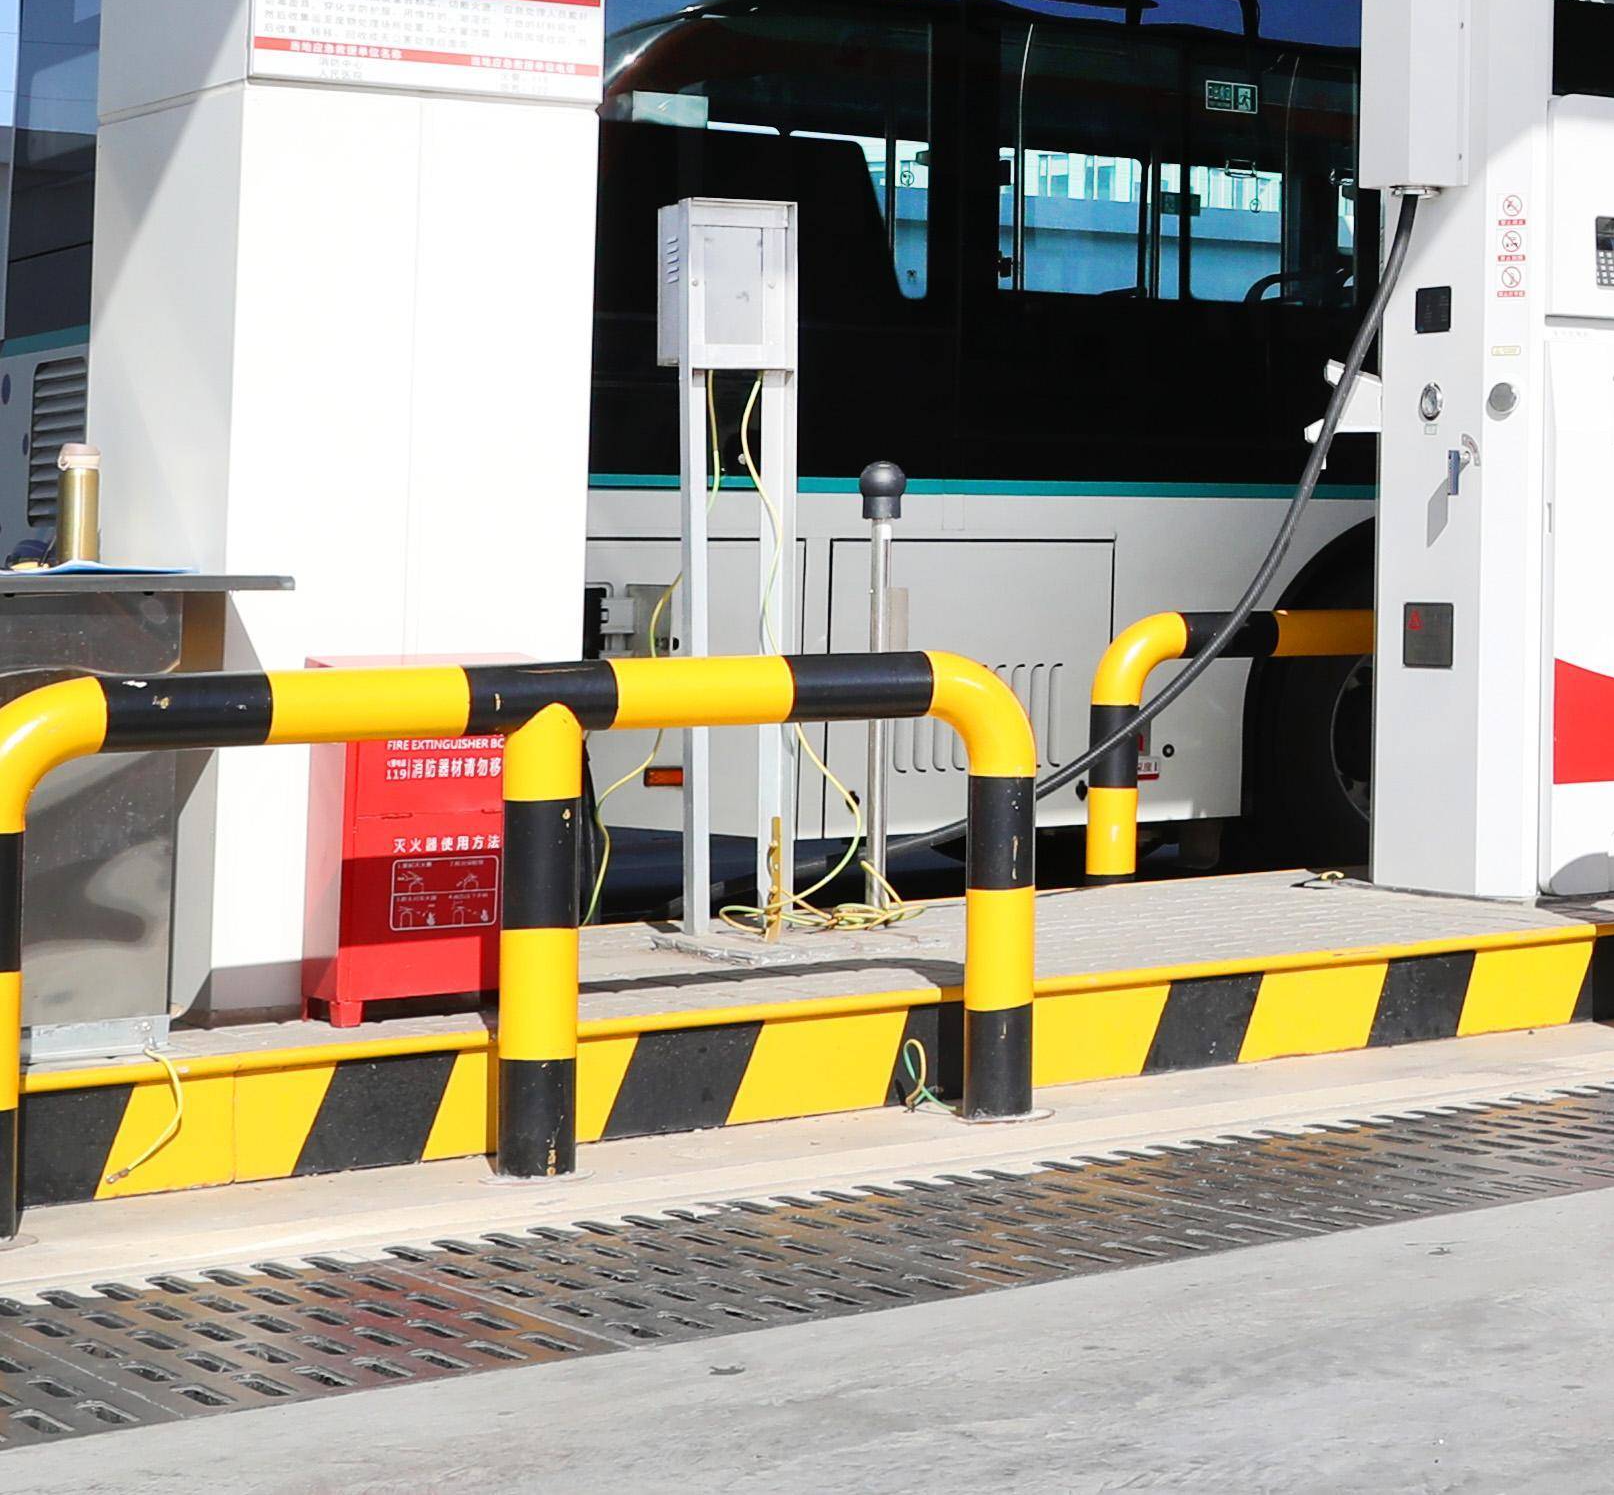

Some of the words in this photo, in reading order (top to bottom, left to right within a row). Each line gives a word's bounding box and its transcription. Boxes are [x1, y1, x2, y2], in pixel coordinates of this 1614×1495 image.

[386, 739, 409, 751] FIRE
[411, 738, 489, 750] EXTINGUISHER
[386, 769, 407, 780] 119
[393, 834, 500, 854] 灭火器使用方法
